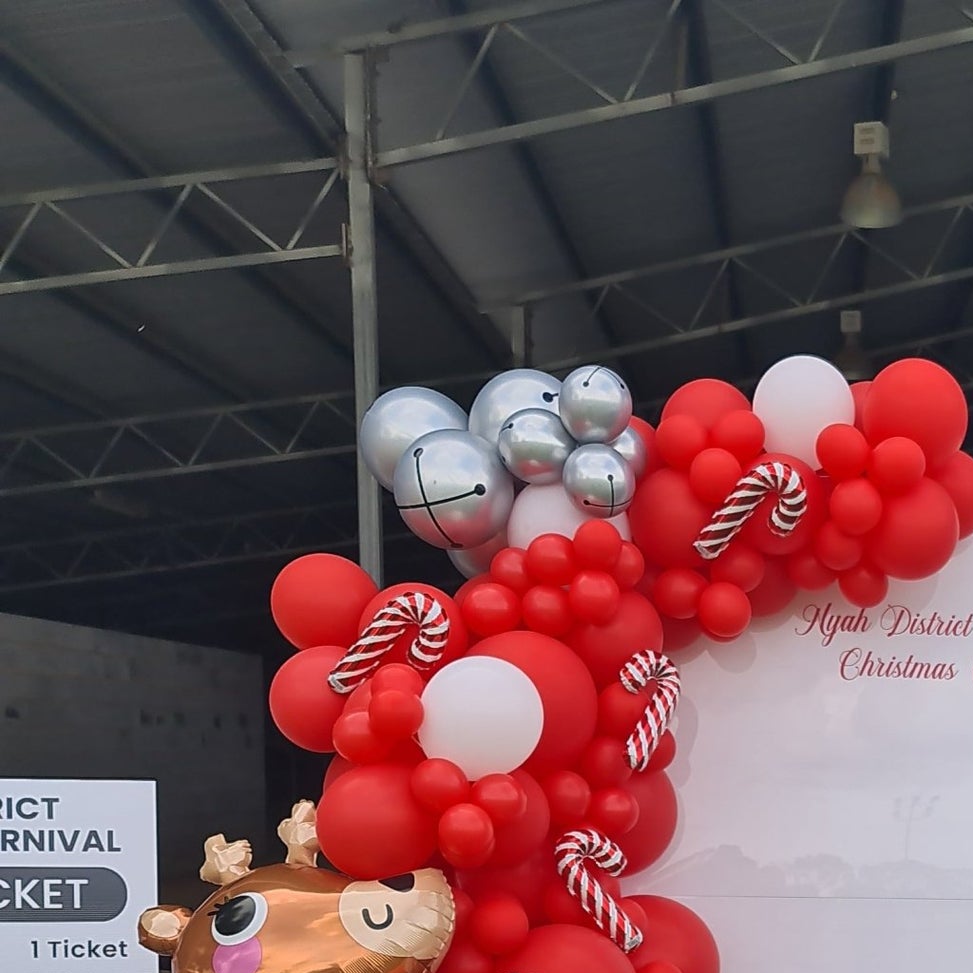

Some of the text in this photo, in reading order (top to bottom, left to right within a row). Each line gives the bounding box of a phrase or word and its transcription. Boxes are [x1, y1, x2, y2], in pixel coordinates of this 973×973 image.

[795, 603, 872, 647] Nyah
[839, 647, 960, 681] Christmas
[0, 797, 60, 820] ICT
[31, 939, 129, 959] 1 Ticket
